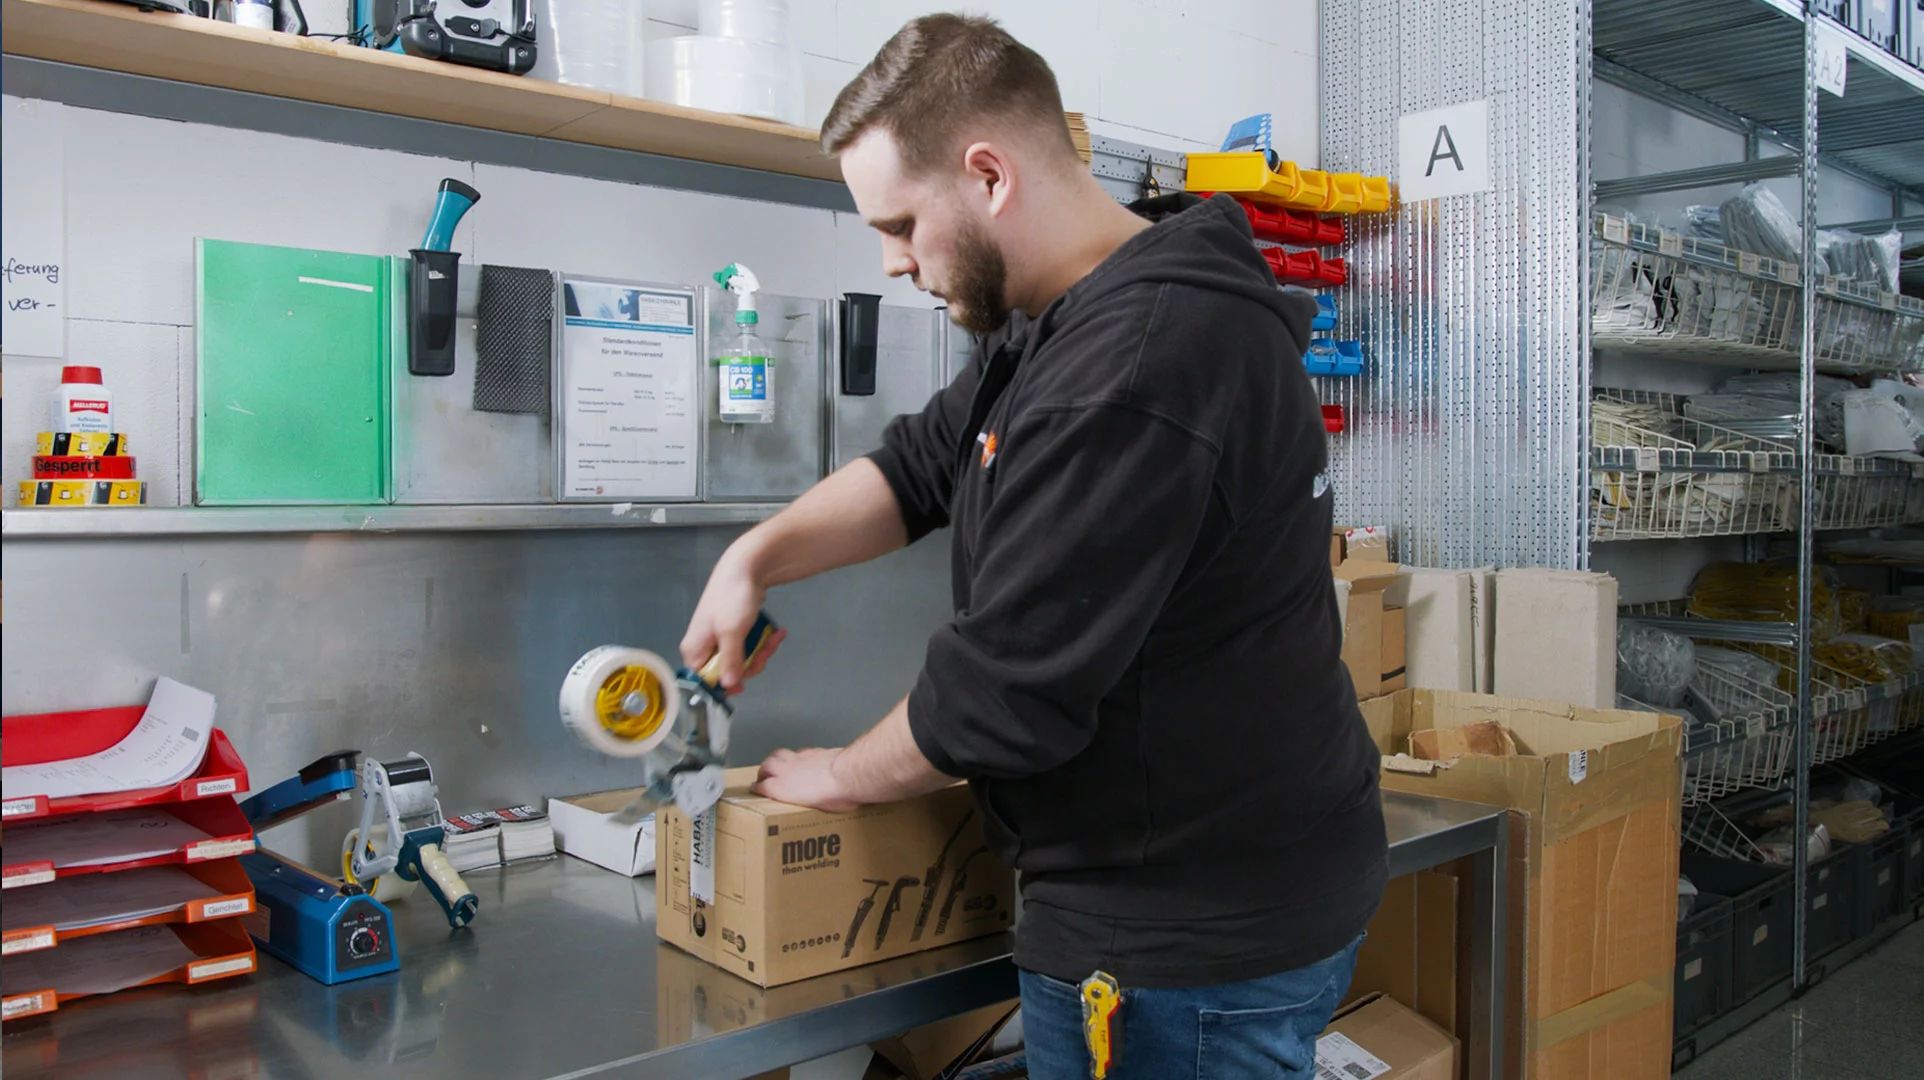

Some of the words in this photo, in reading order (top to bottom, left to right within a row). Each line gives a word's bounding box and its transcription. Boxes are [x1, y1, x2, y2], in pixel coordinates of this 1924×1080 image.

[1424, 124, 1465, 177] A
[2, 257, 60, 284] ferung
[35, 458, 101, 475] Gesperrt
[782, 833, 841, 865] more
[782, 863, 803, 876] than
[804, 858, 840, 872] welding
